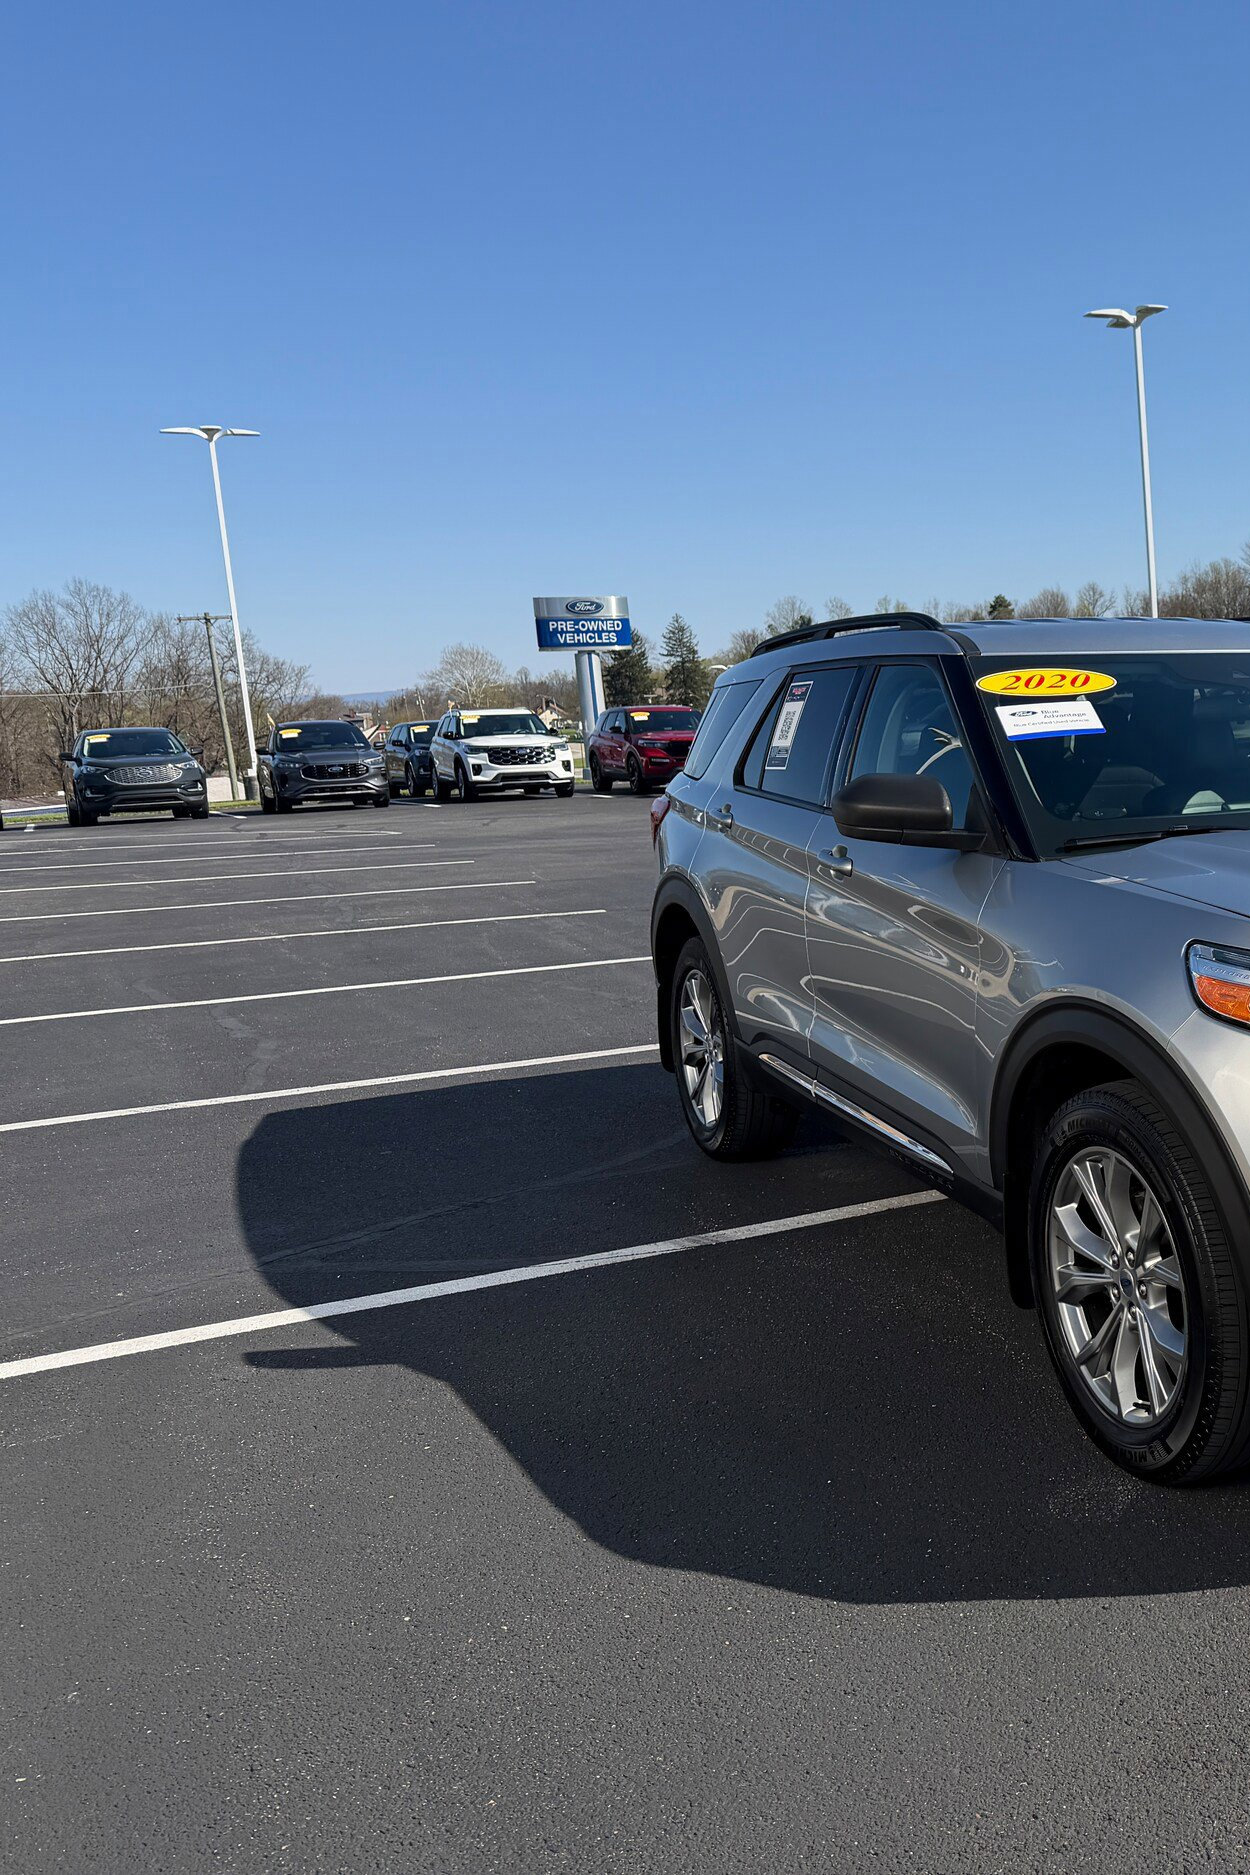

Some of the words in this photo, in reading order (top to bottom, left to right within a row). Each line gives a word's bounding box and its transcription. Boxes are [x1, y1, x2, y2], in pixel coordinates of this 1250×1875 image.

[549, 620, 622, 632] PRE-OWNED
[557, 632, 618, 644] VEHICLES
[1000, 673, 1091, 690] 2020
